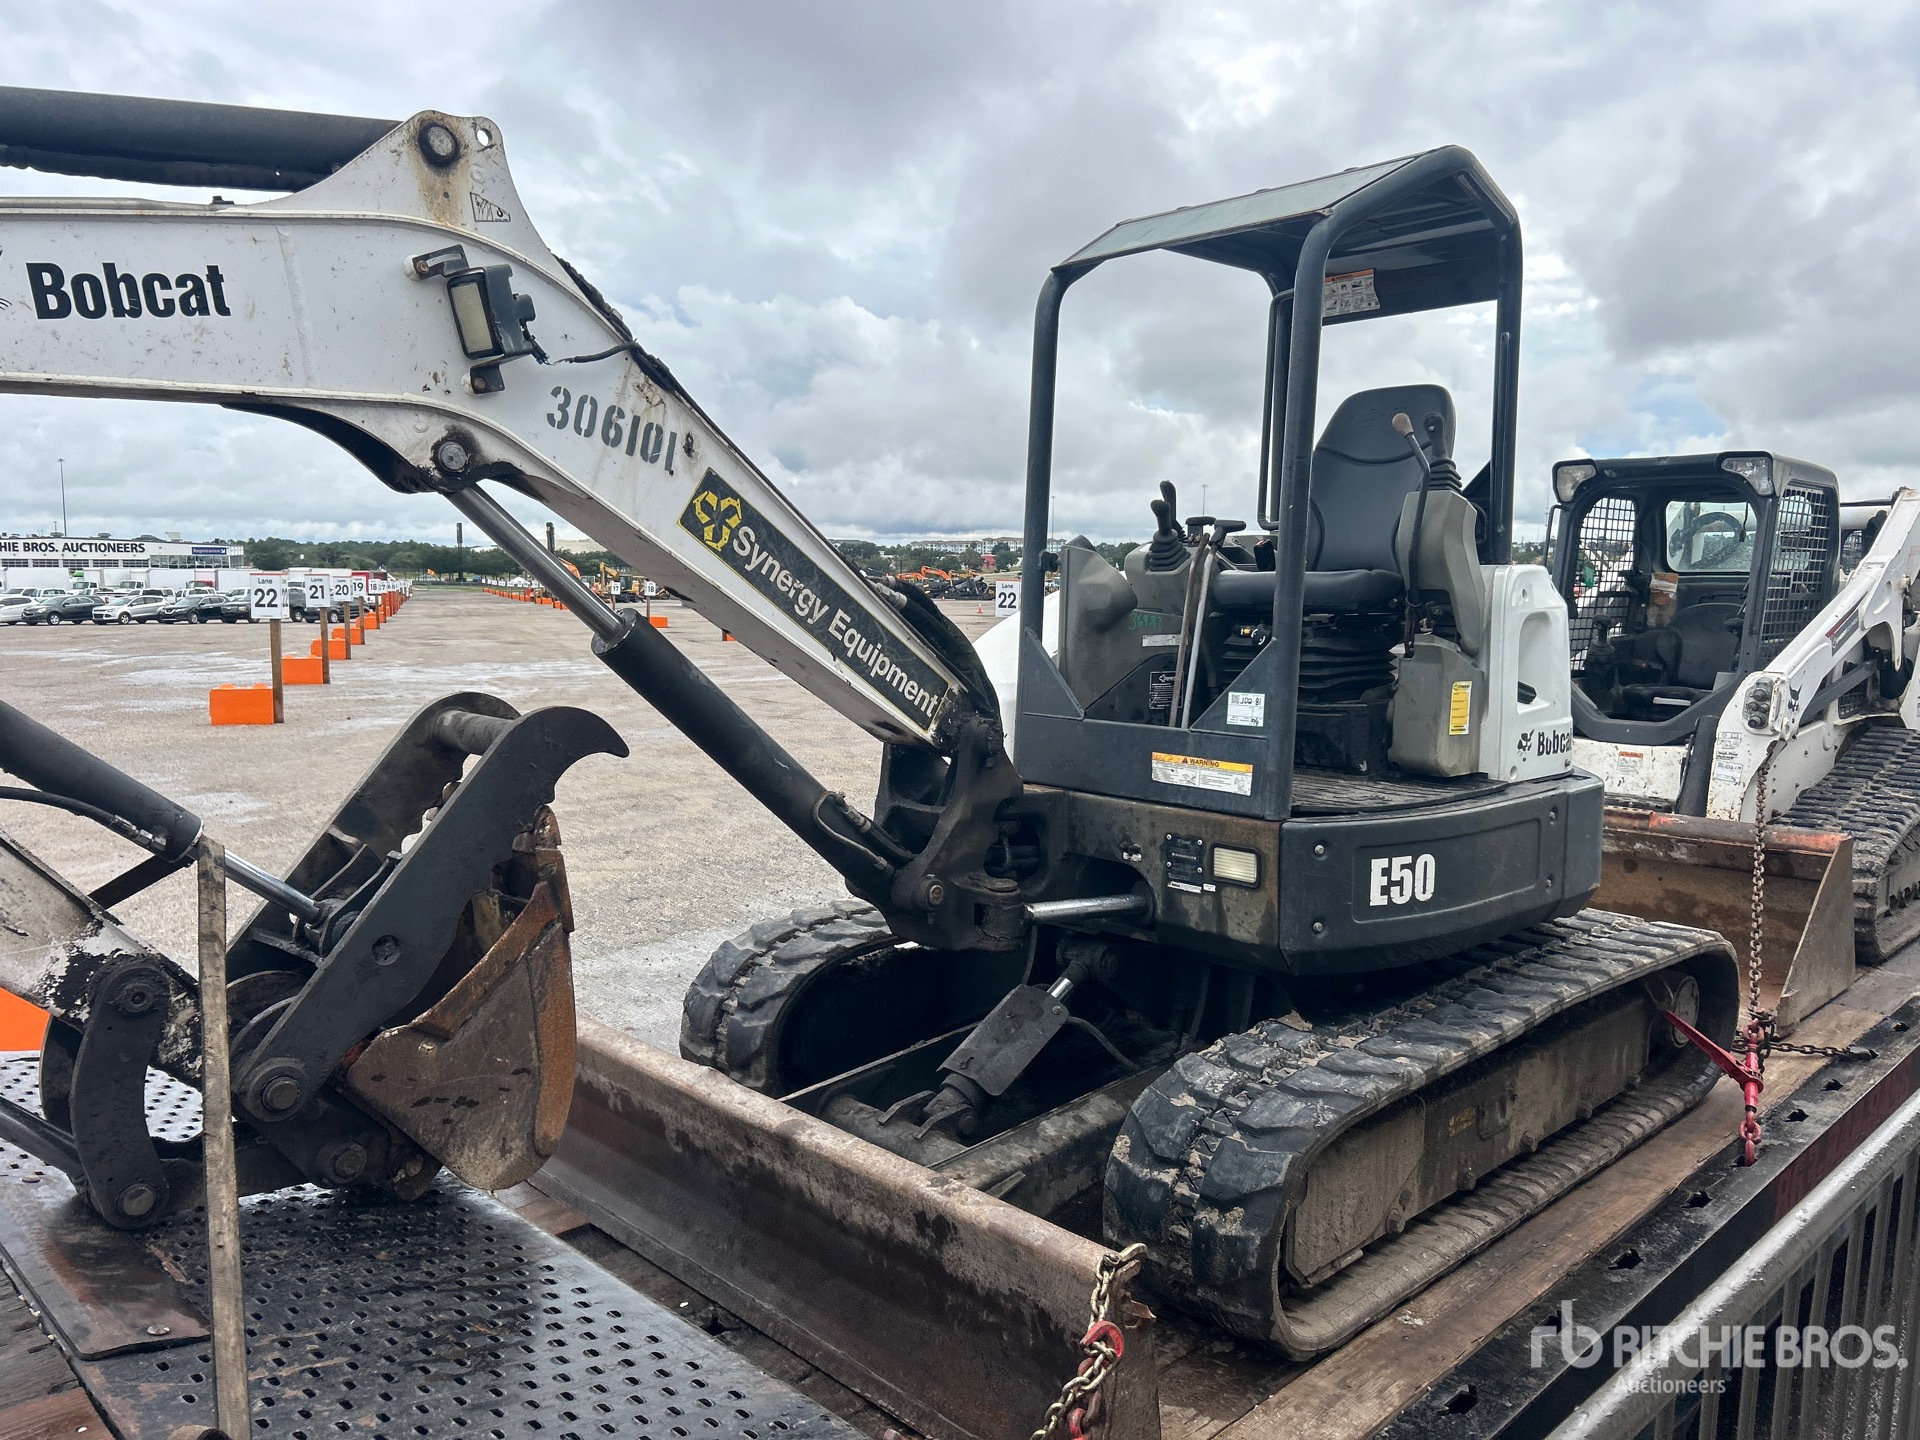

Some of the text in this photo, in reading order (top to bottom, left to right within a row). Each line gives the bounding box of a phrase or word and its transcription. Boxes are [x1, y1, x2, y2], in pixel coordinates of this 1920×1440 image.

[25, 262, 231, 320] Bobcat
[546, 385, 678, 471] 306101
[22, 542, 59, 553] BROS.
[62, 542, 146, 554] AUCTIONEERS
[258, 577, 273, 585] Lane
[352, 582, 364, 592] 19
[370, 583, 378, 591] 18
[254, 588, 279, 608] 22
[309, 584, 325, 600] 21
[335, 584, 349, 596] 20
[998, 591, 1017, 609] 22
[732, 525, 940, 718] Synergy Equipment
[1189, 757, 1220, 768] WARNING
[1369, 853, 1436, 907] E50
